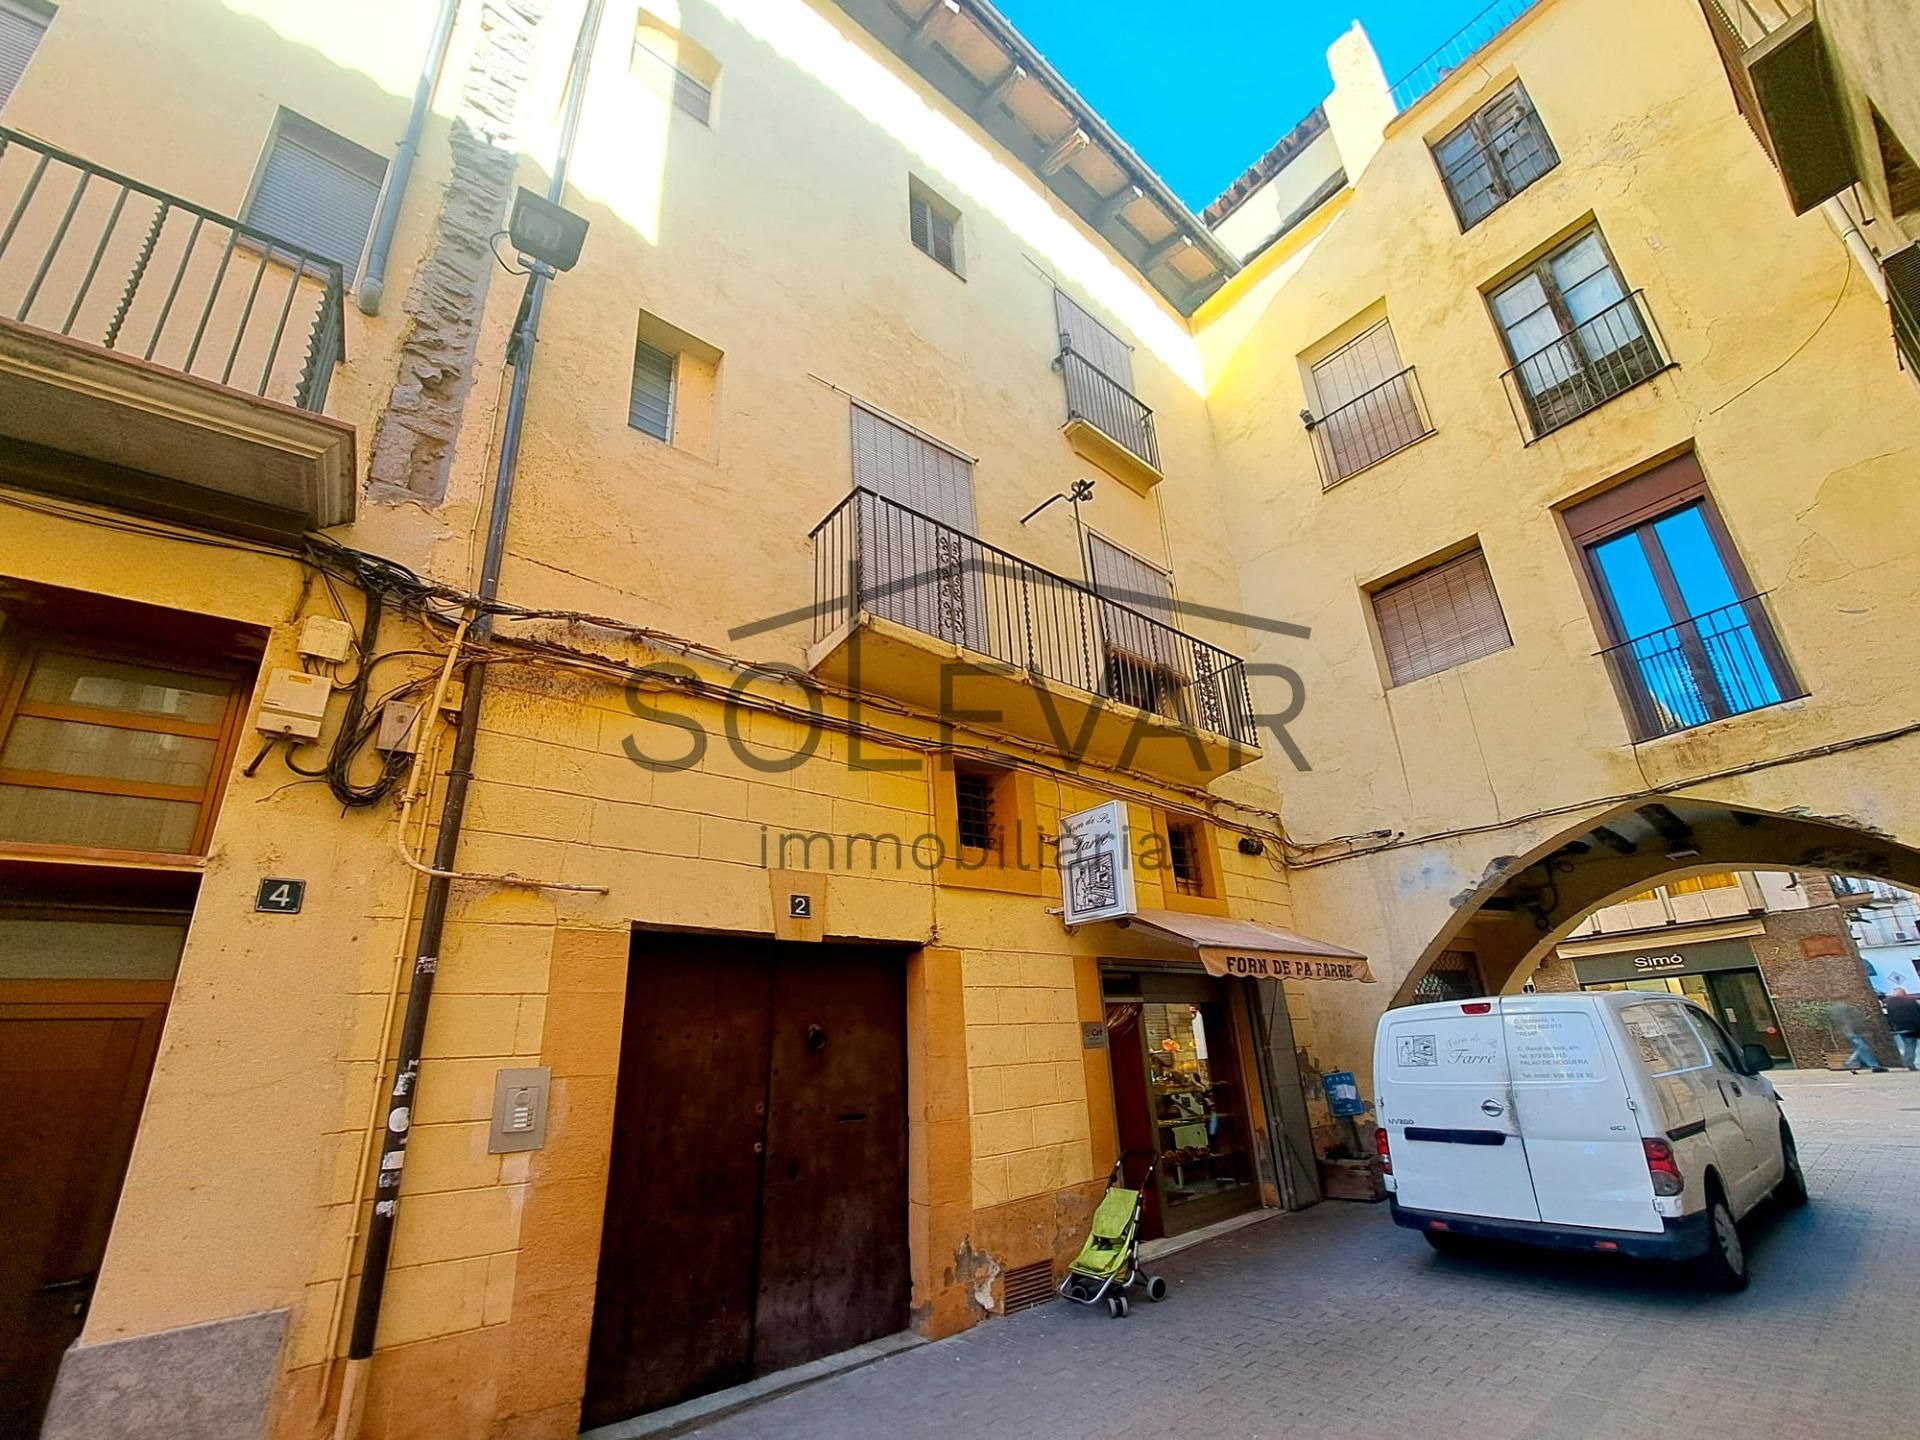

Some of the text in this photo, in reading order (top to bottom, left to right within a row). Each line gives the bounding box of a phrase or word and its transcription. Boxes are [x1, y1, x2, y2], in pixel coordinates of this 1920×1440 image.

[269, 885, 290, 907] 4
[795, 898, 806, 913] 2
[1226, 957, 1353, 978] FORN DE PA FARRÉ
[1634, 953, 1683, 967] Simó
